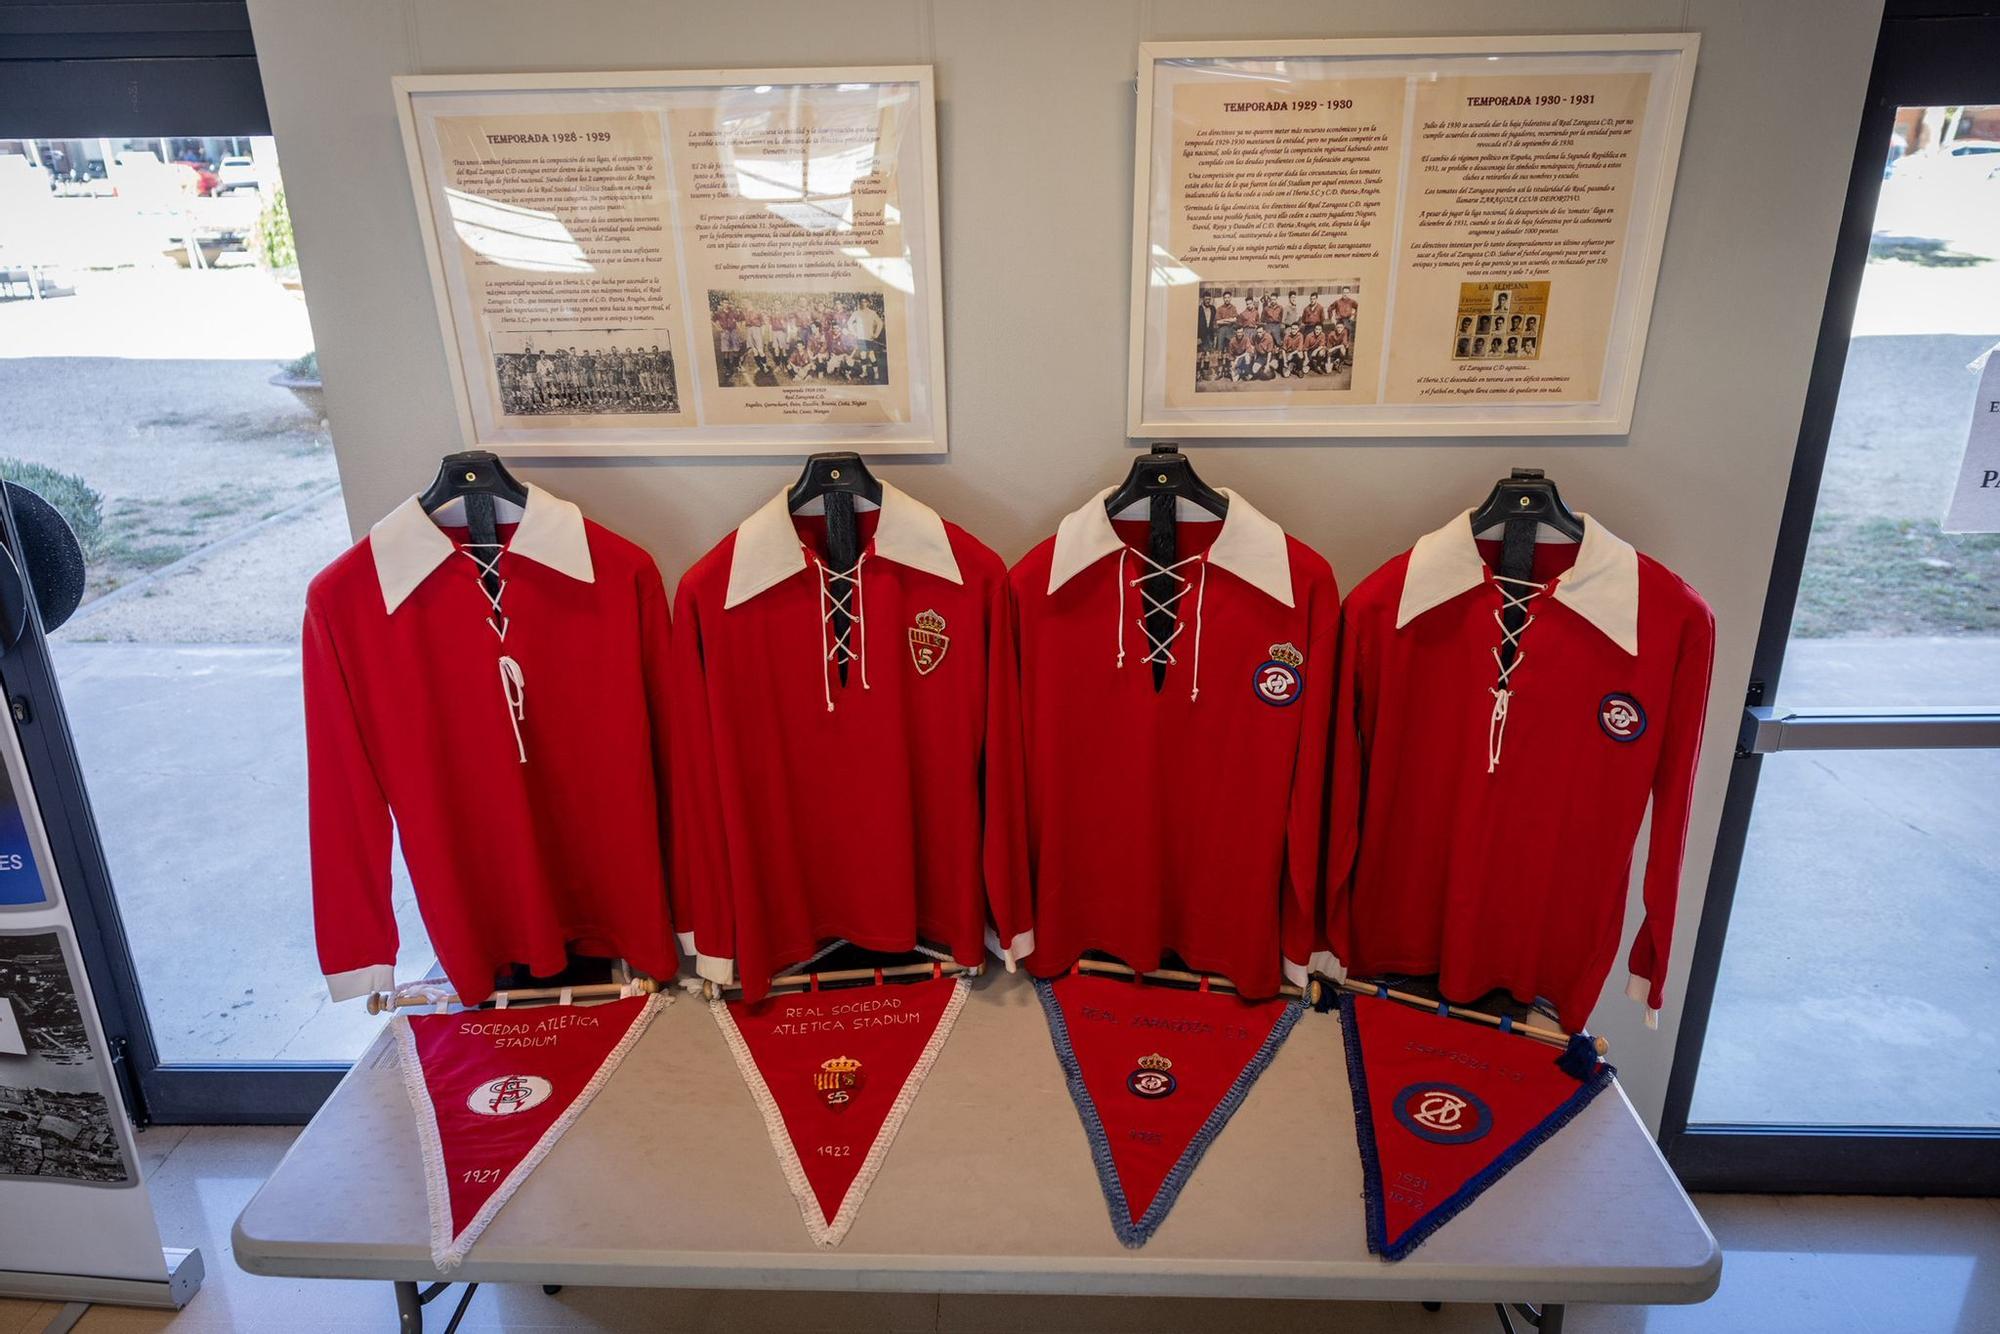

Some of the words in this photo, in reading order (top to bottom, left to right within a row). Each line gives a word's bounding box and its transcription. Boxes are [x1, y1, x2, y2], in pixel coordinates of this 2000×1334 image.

[1224, 102, 1287, 111] TEMPORADA
[1292, 101, 1317, 110] 1929
[1327, 100, 1352, 109] 1930
[1467, 96, 1531, 106] TEMPORADA
[1535, 96, 1560, 105] 1930
[1570, 95, 1594, 104] 1931
[486, 134, 548, 143] TEMPORADA
[552, 133, 577, 142] 1928
[586, 133, 610, 142] 1929
[786, 1008, 823, 1018] REAL
[831, 998, 902, 1016] SOCIEDAD
[459, 1022, 530, 1036] SOCIEDAD
[536, 1014, 600, 1031] ATLETICA
[772, 1020, 845, 1035] ATLETICA
[852, 1012, 920, 1030] STADIUM
[1080, 1006, 1119, 1025] REAL
[1130, 1016, 1213, 1034] ZARAGOZA
[494, 1034, 557, 1049] STADIUM
[817, 1146, 850, 1157] 1922
[463, 1168, 500, 1183] 1921
